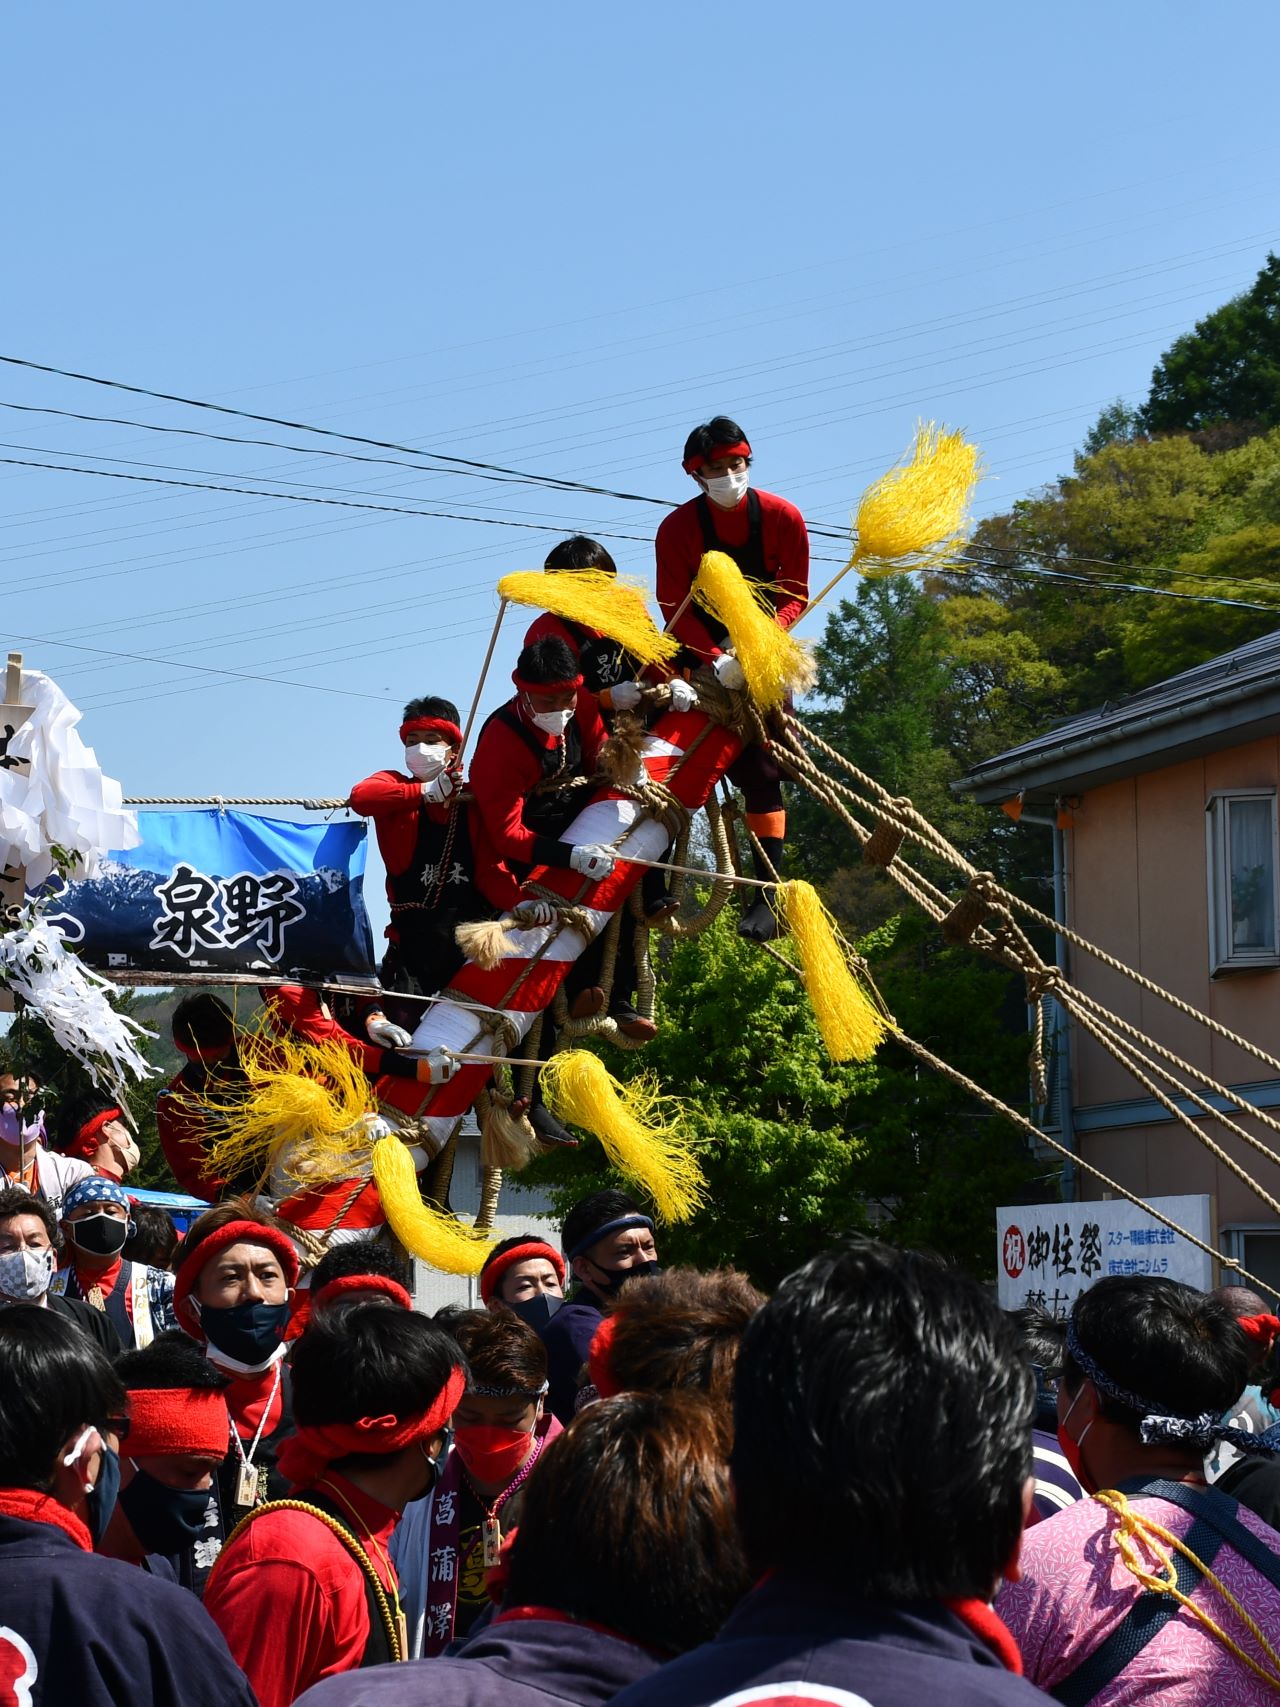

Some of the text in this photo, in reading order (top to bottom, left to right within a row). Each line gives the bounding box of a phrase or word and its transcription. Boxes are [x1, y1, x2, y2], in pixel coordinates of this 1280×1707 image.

[150, 863, 308, 962] 泉野
[1005, 1221, 1102, 1280] 祝 御柱祭
[1108, 1257, 1168, 1275] 株式会社ニシムラ
[426, 1490, 457, 1640] 菖蒲澤
